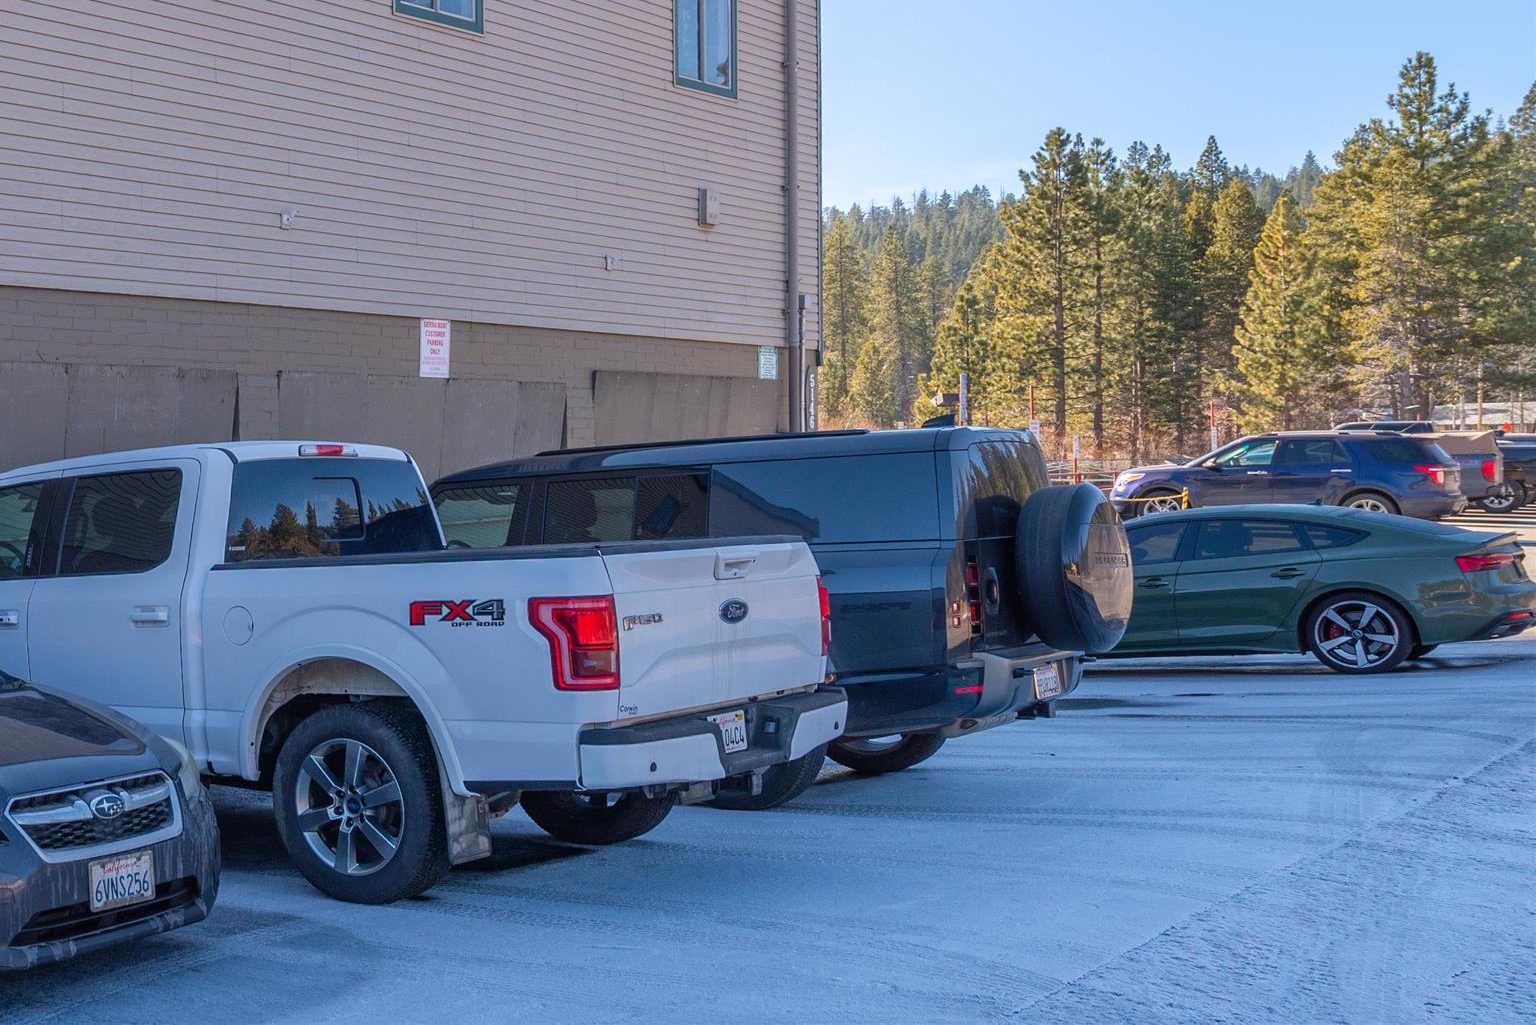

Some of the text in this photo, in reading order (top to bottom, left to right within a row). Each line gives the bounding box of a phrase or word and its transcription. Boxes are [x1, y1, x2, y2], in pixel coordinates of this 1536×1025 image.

[425, 330, 446, 338] CUSTOMER
[409, 599, 505, 626] FX4
[727, 603, 745, 618] Ford
[102, 858, 140, 874] California
[95, 870, 150, 903] 6VNS256
